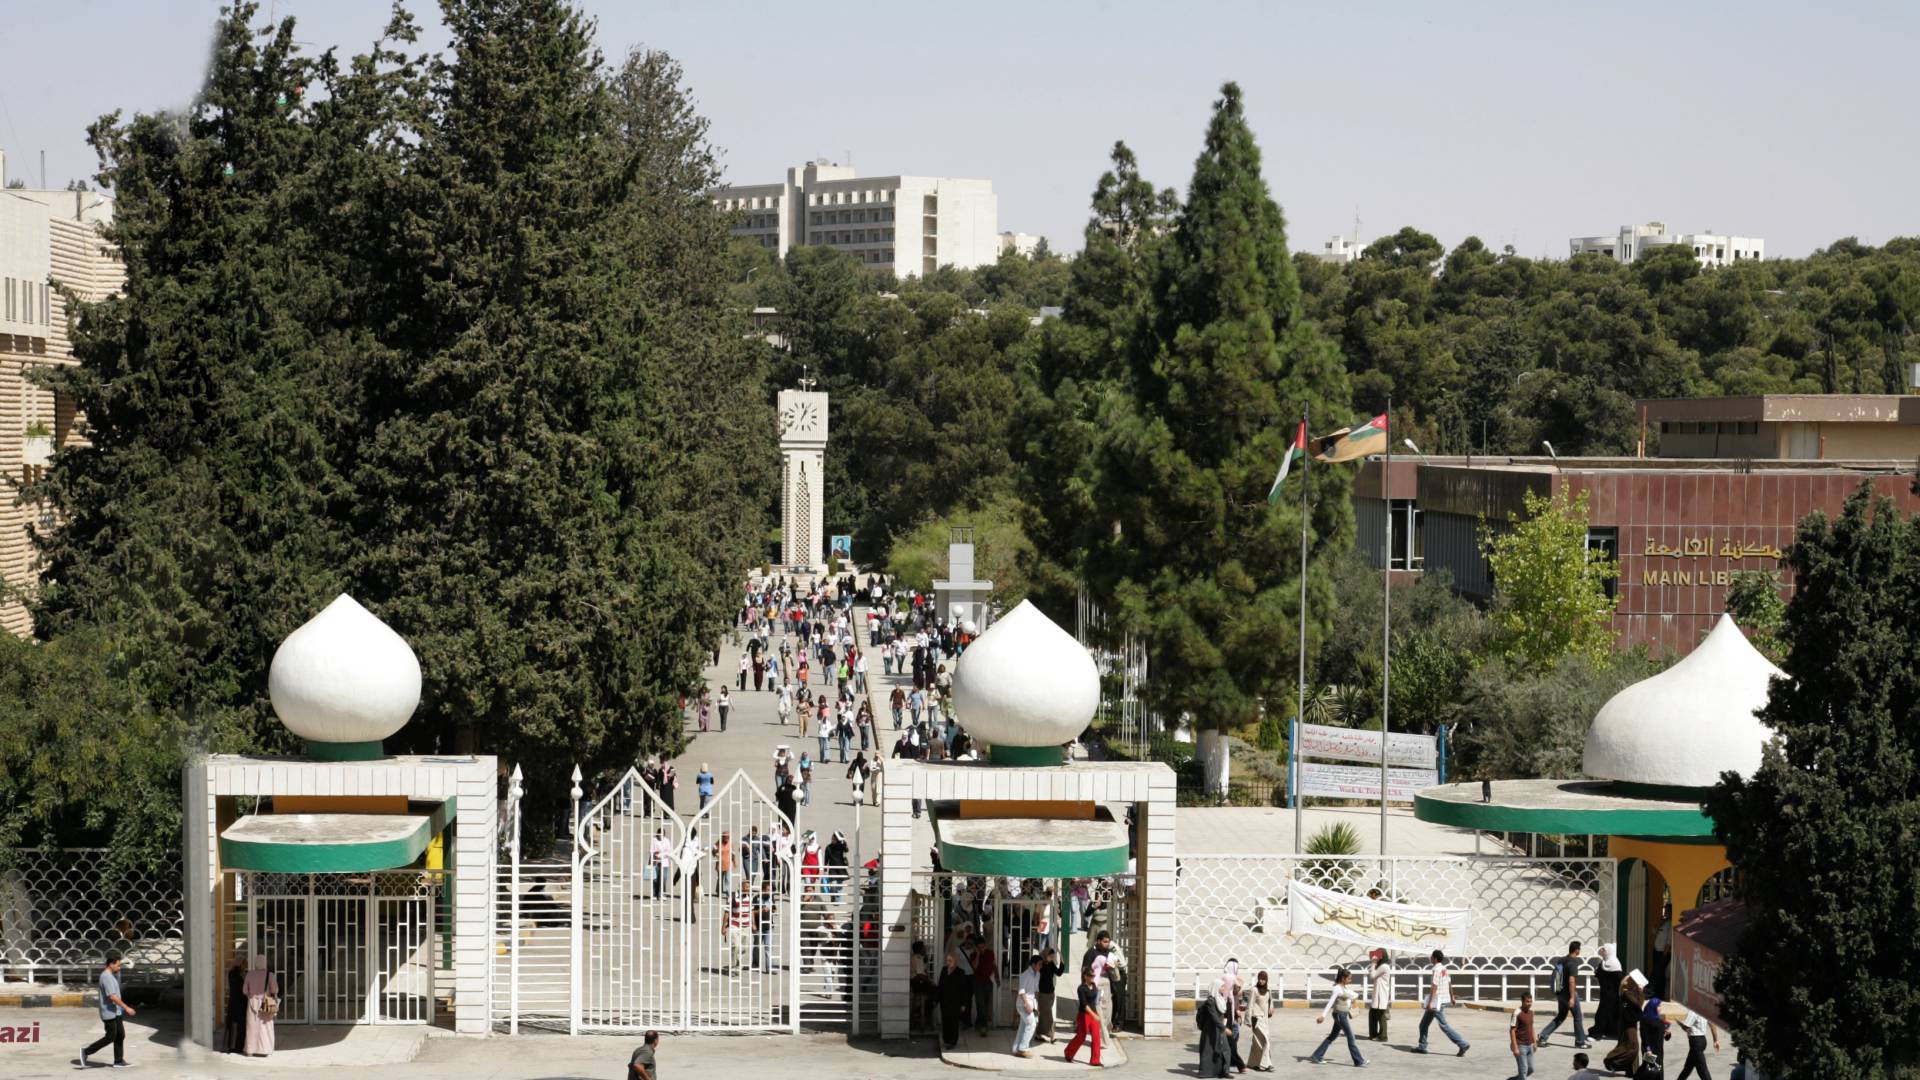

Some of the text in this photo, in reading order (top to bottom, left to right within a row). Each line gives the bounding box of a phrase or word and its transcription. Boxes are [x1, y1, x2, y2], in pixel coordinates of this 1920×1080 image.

[1644, 536, 1782, 562] مكتبة الجامعة
[1643, 571, 1691, 585] MAIN
[1313, 903, 1365, 925] المستعمل
[1356, 912, 1400, 933] الكتاب
[1400, 921, 1448, 942] معرض
